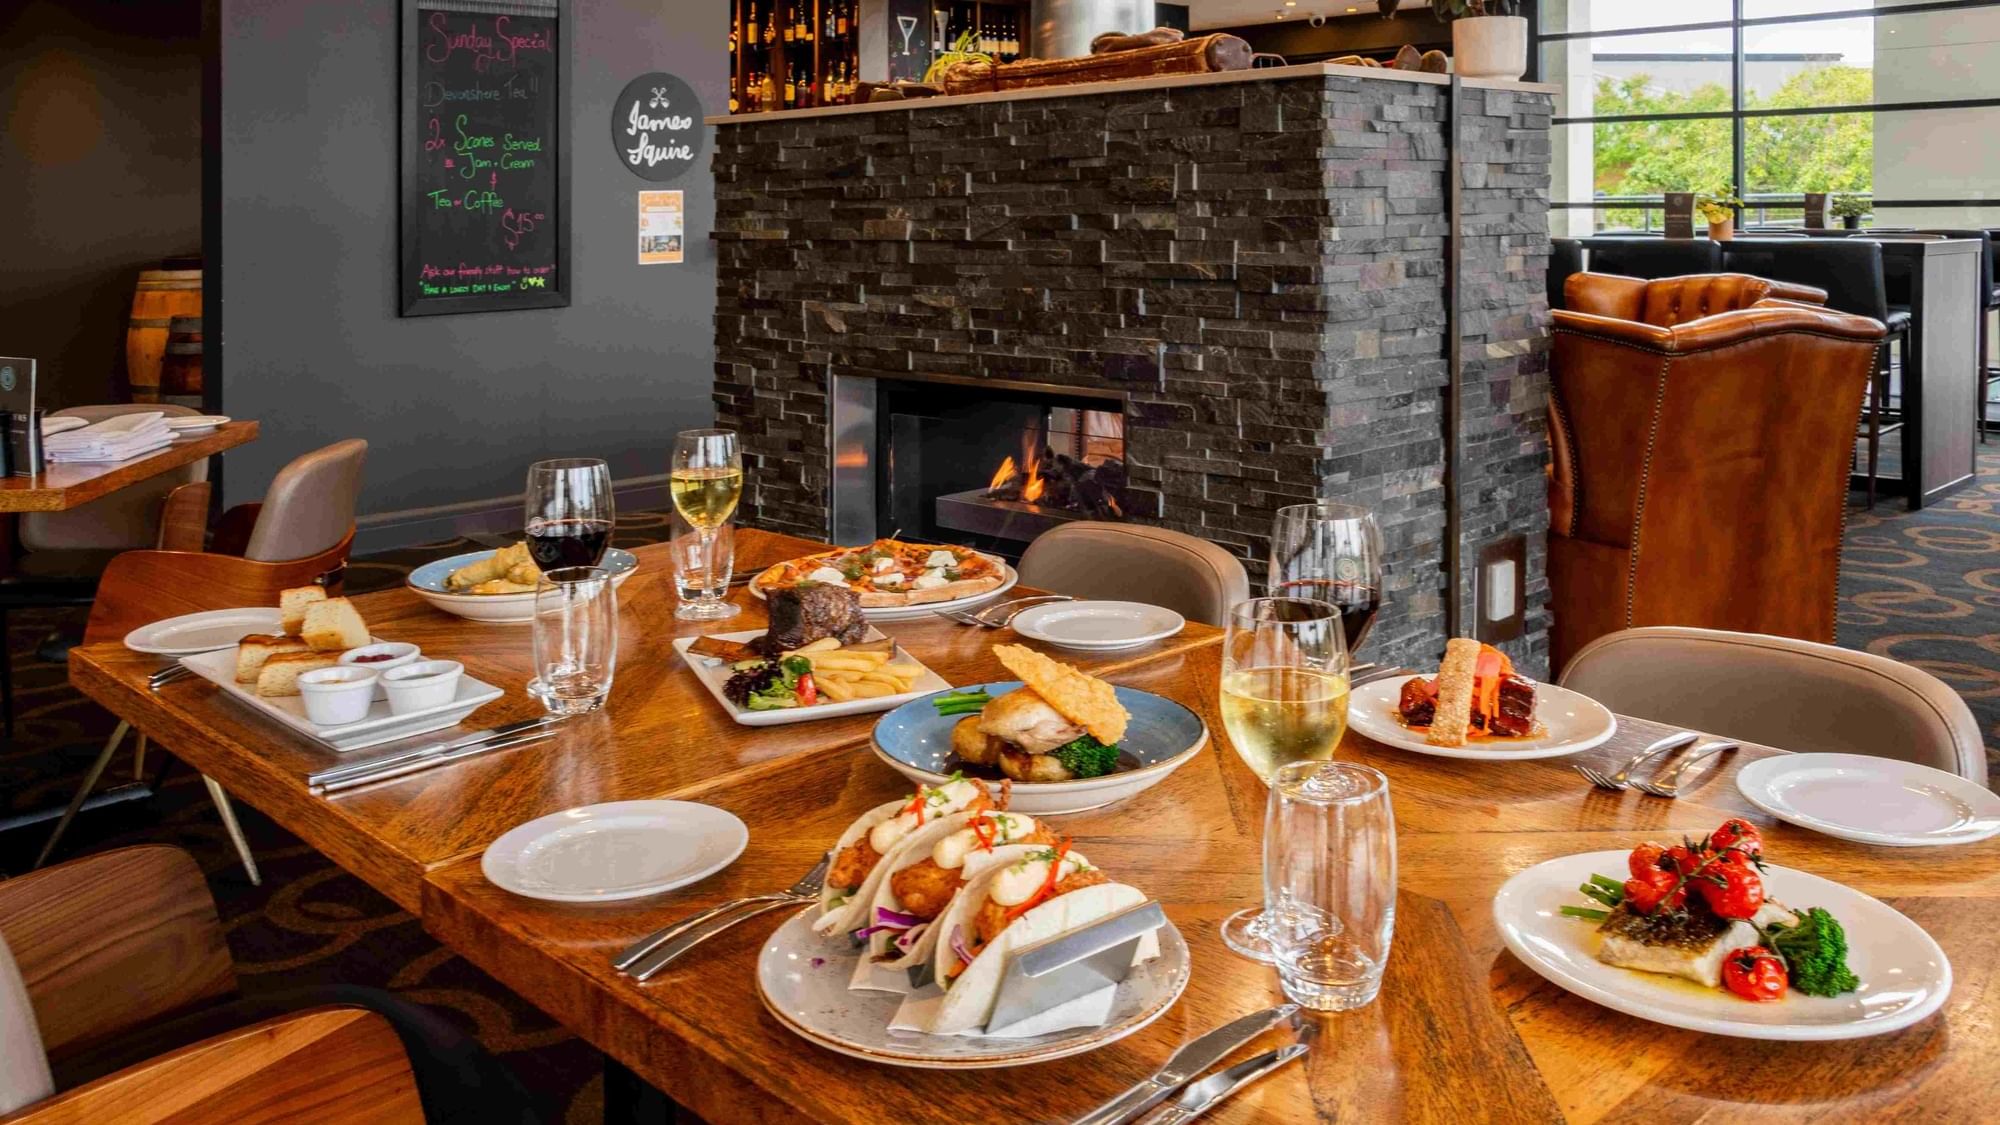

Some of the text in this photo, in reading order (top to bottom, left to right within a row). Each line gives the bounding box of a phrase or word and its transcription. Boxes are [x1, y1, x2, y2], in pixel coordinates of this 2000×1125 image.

[427, 12, 553, 72] Sunday Special
[454, 114, 496, 151] Scones
[502, 133, 542, 151] Served
[627, 100, 692, 136] James
[457, 153, 491, 179] Jam
[501, 153, 535, 169] Cream
[627, 132, 694, 167] Squire
[427, 189, 453, 210] Tea
[464, 190, 505, 215] Coffee
